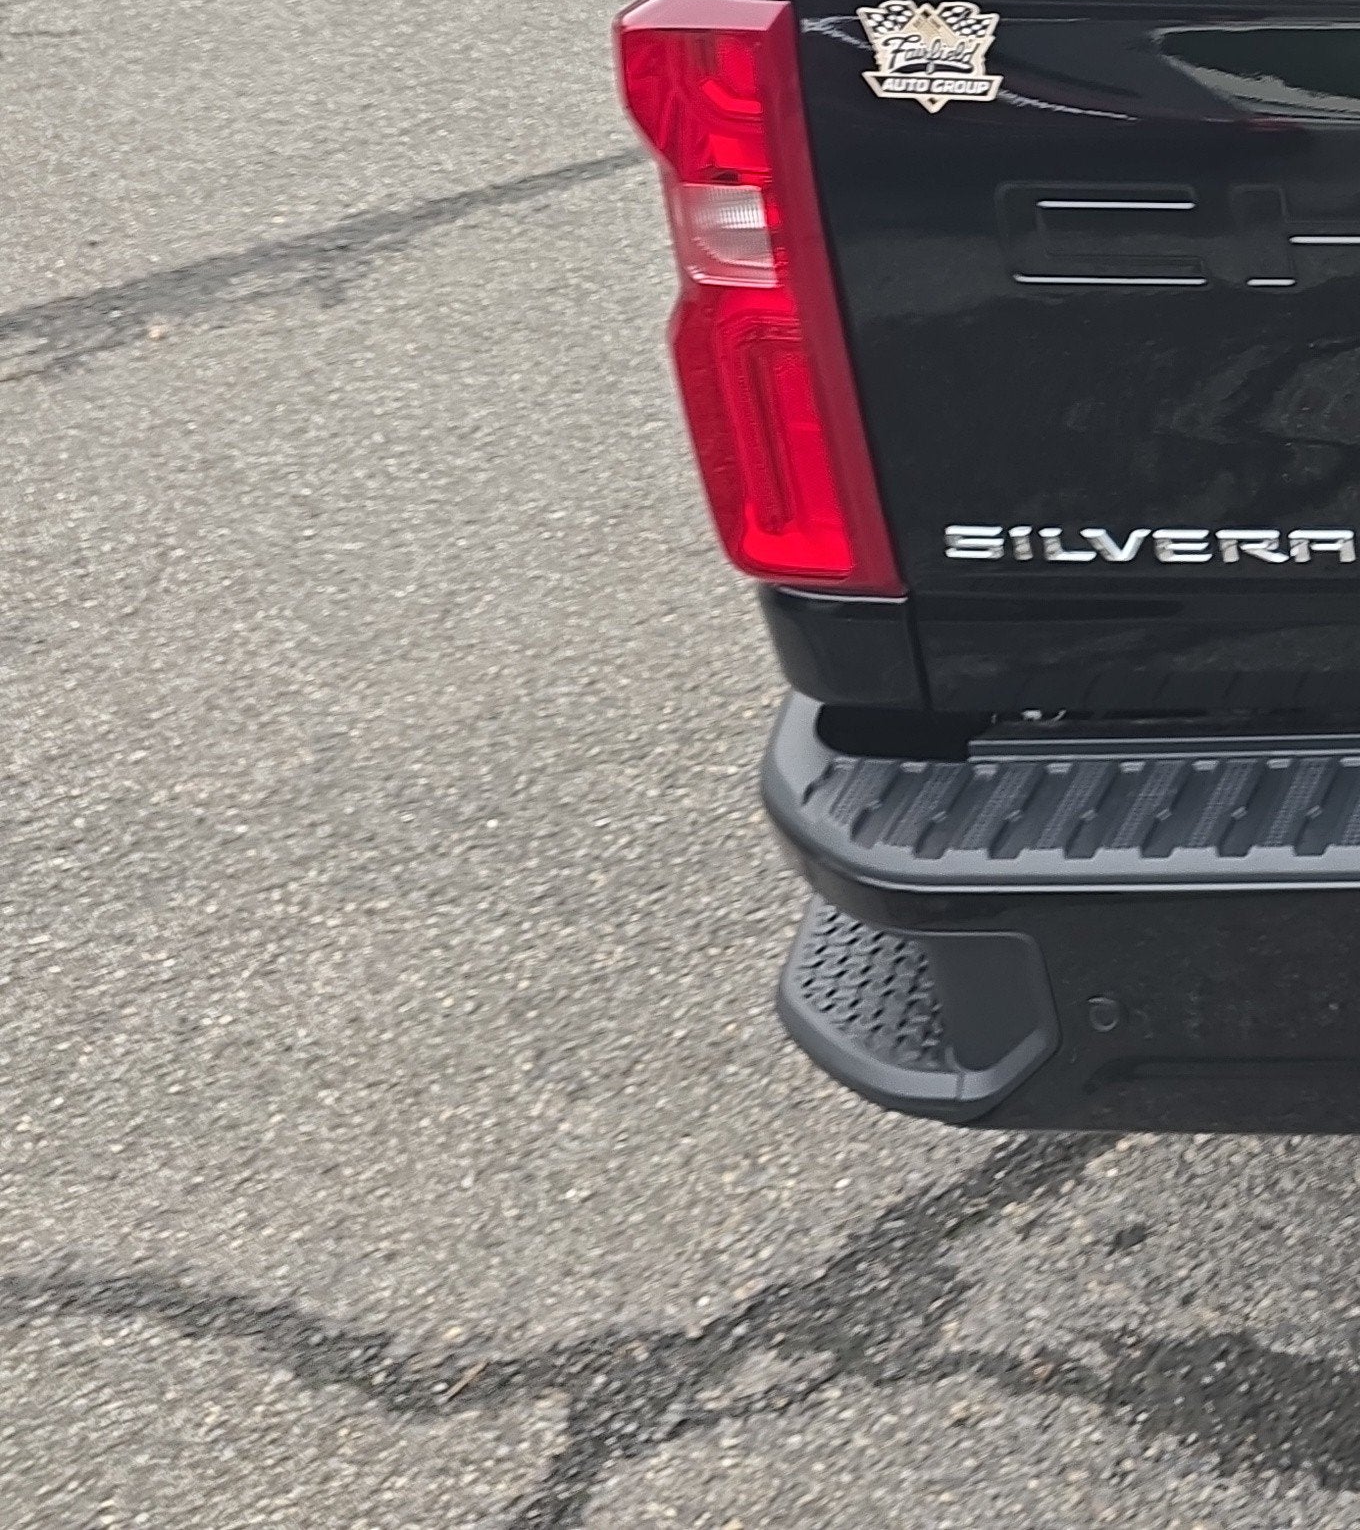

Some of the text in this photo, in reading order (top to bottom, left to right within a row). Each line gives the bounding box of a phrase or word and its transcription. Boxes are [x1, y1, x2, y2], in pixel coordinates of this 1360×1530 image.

[882, 35, 980, 74] Fairfield
[882, 78, 992, 94] AUTO GROUP
